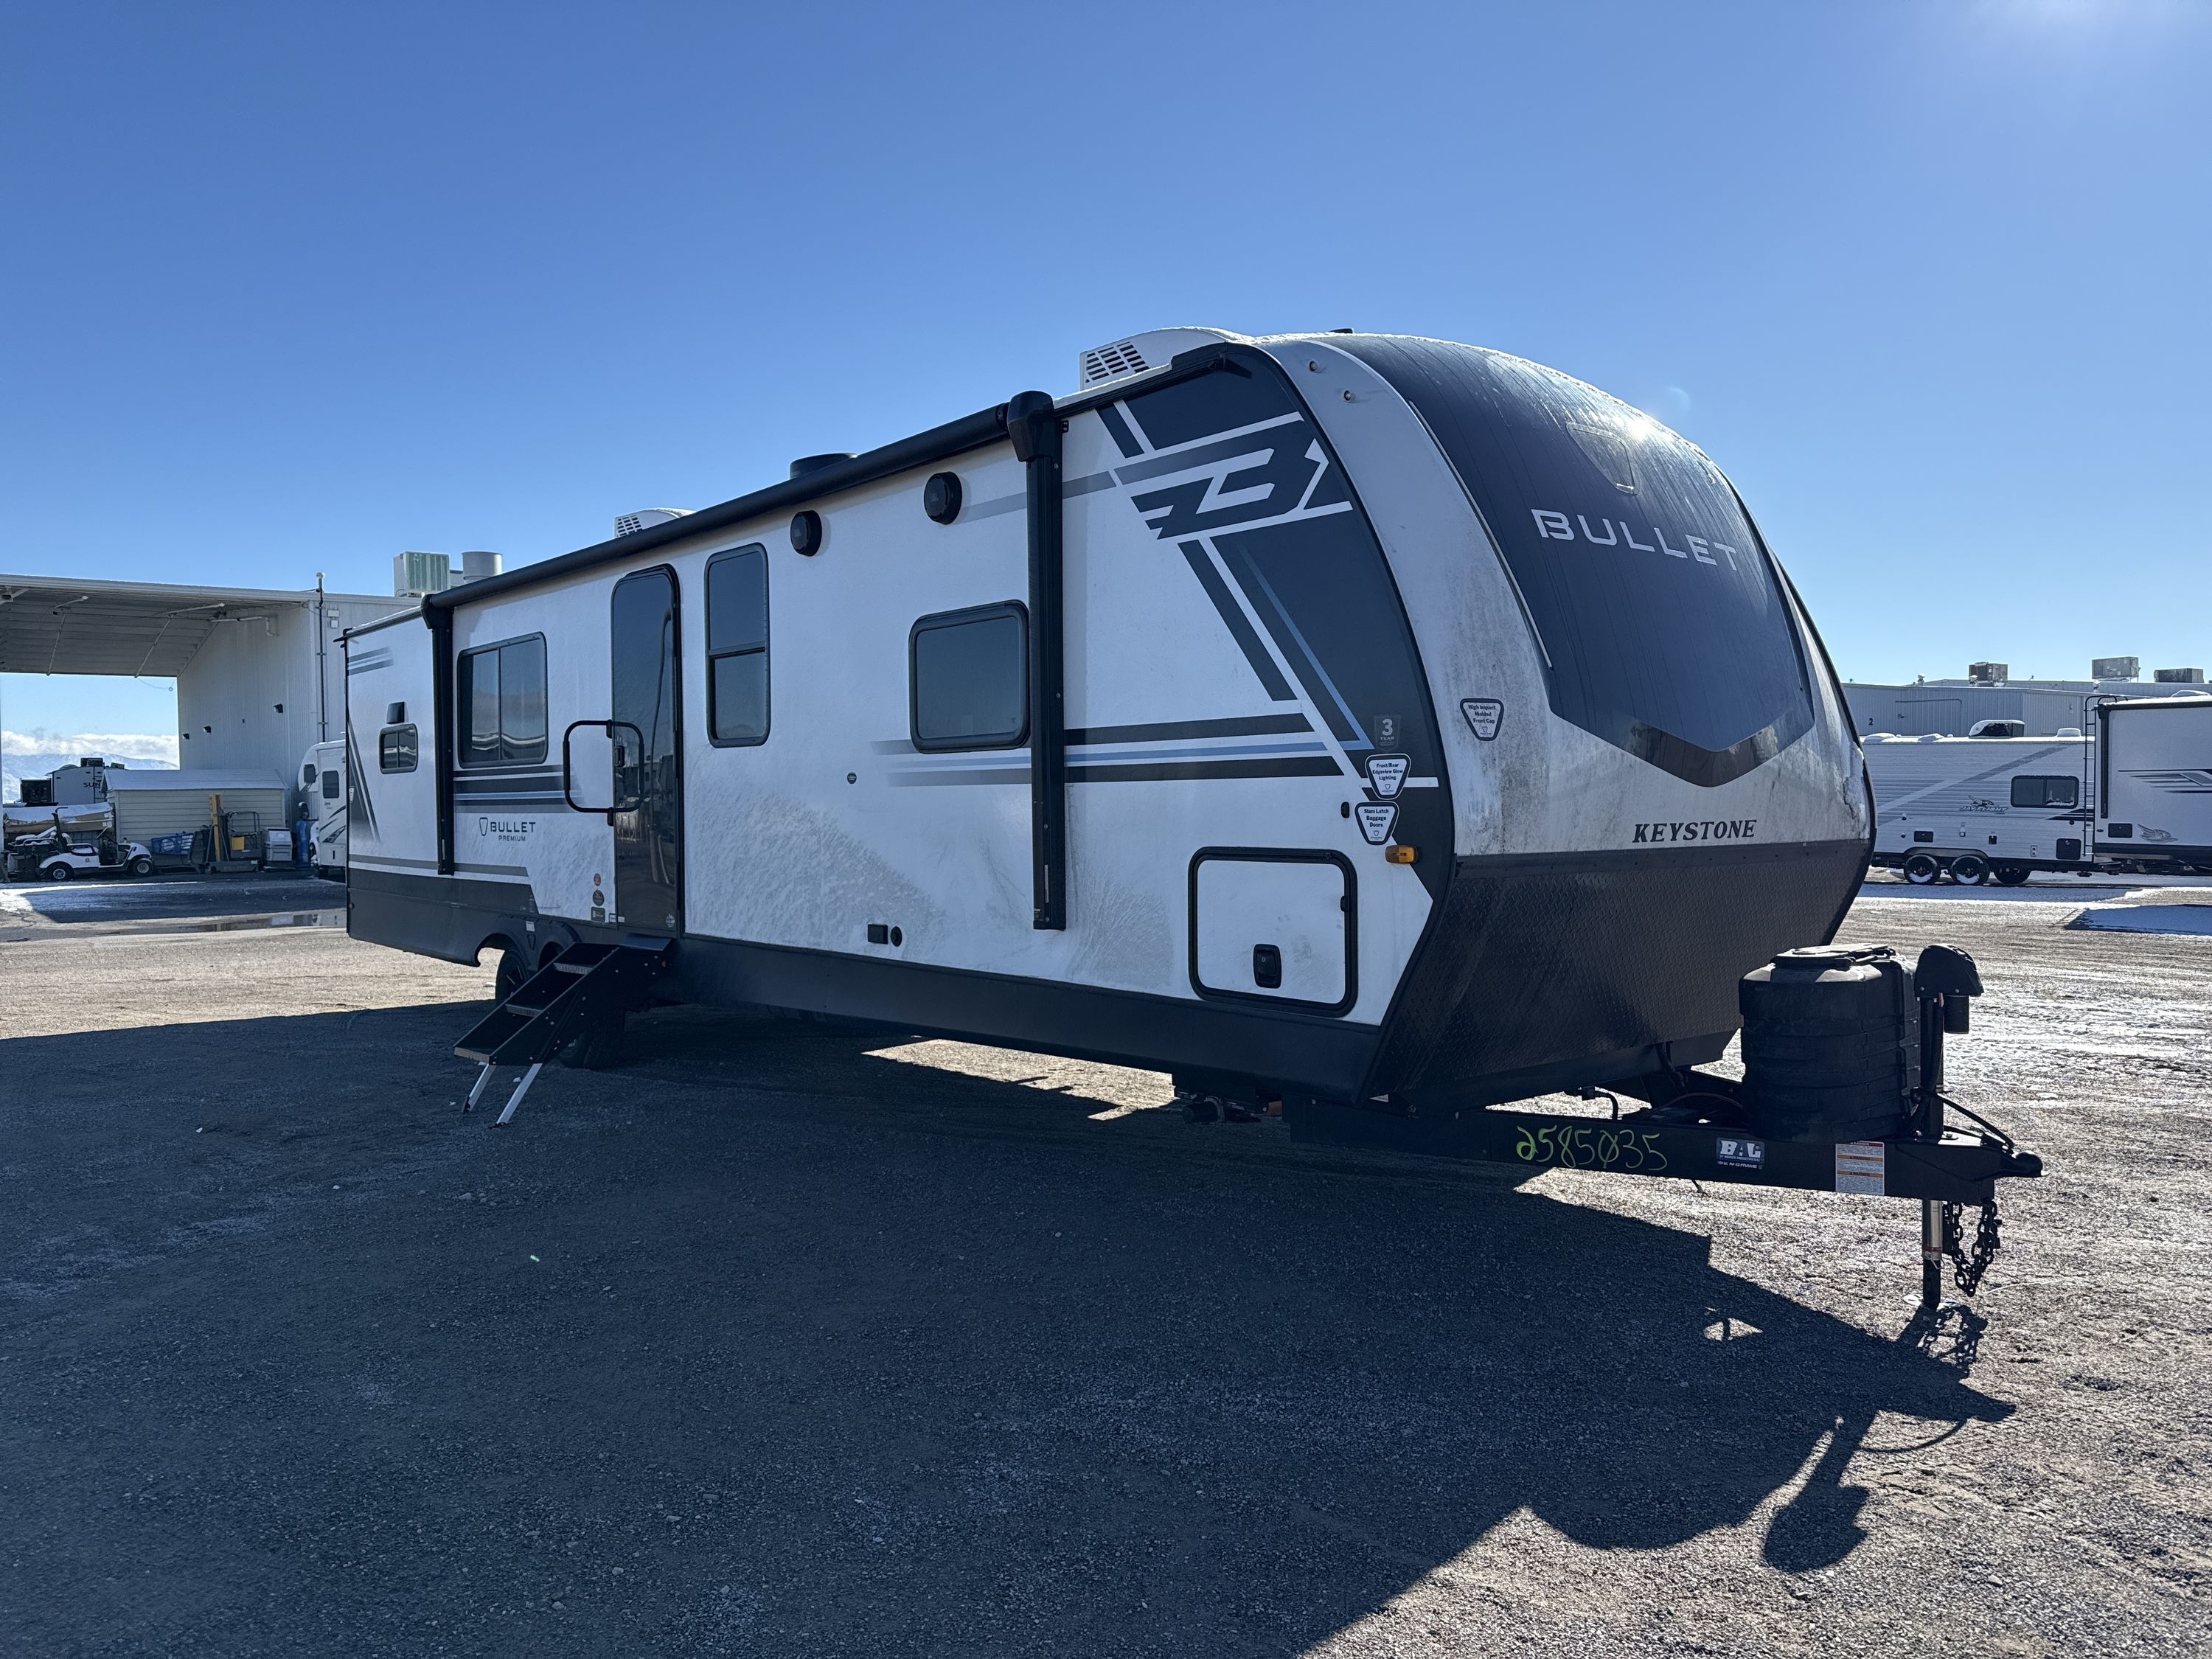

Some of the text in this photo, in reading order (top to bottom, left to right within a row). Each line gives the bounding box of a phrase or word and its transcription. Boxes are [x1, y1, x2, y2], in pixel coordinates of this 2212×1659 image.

[1531, 508, 1737, 571] BULLET
[1382, 718, 1393, 736] 3
[1868, 717, 1874, 726] 2
[490, 821, 536, 832] BULLET
[1632, 819, 1757, 843] KEYSTONE
[1516, 1124, 1668, 1171] 2585035
[1720, 1140, 1761, 1158] BAL
